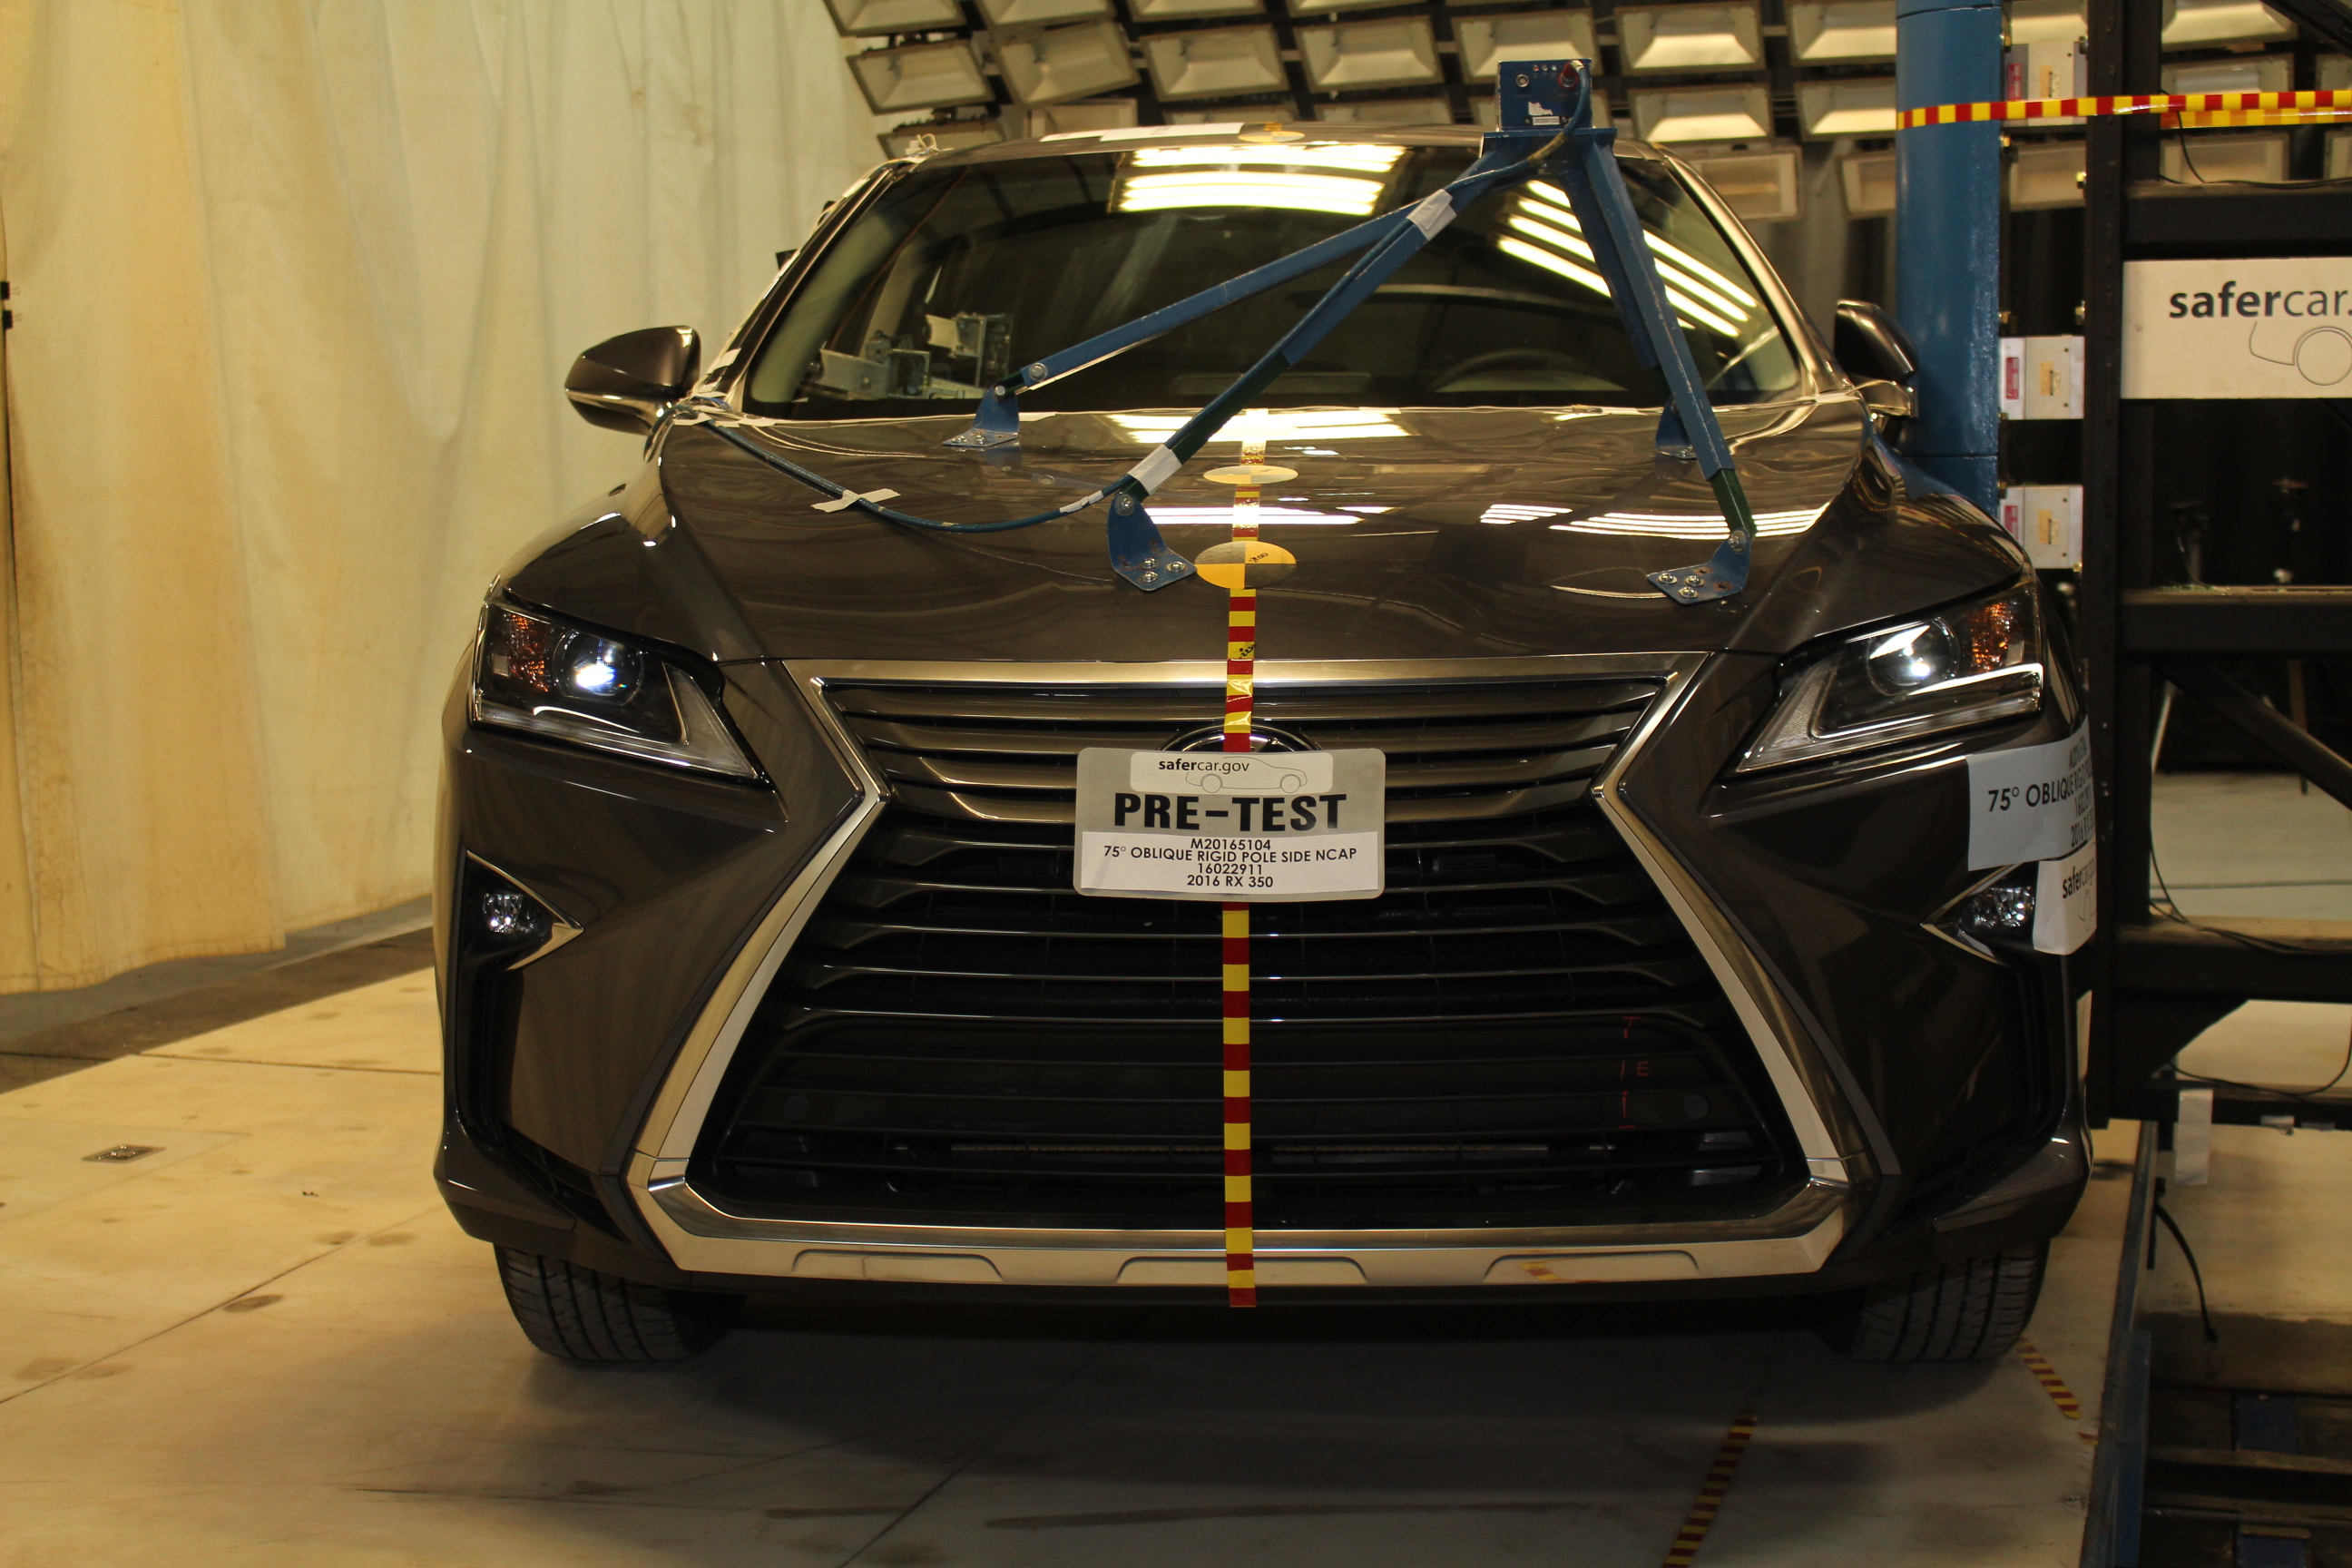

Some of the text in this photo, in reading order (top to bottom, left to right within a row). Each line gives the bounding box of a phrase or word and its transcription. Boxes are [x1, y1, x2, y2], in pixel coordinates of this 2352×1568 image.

[1158, 758, 1250, 774] safercar.gov
[1987, 786, 2020, 813] 75°
[1113, 792, 1348, 832] PRE-TEST
[1190, 838, 1272, 851] M20165104
[1103, 845, 1357, 864] 75° OBLIQUE RIGID POLE SIDE NCAP
[1197, 862, 1263, 876] 16022911
[1186, 874, 1274, 888] 2016 RX 350
